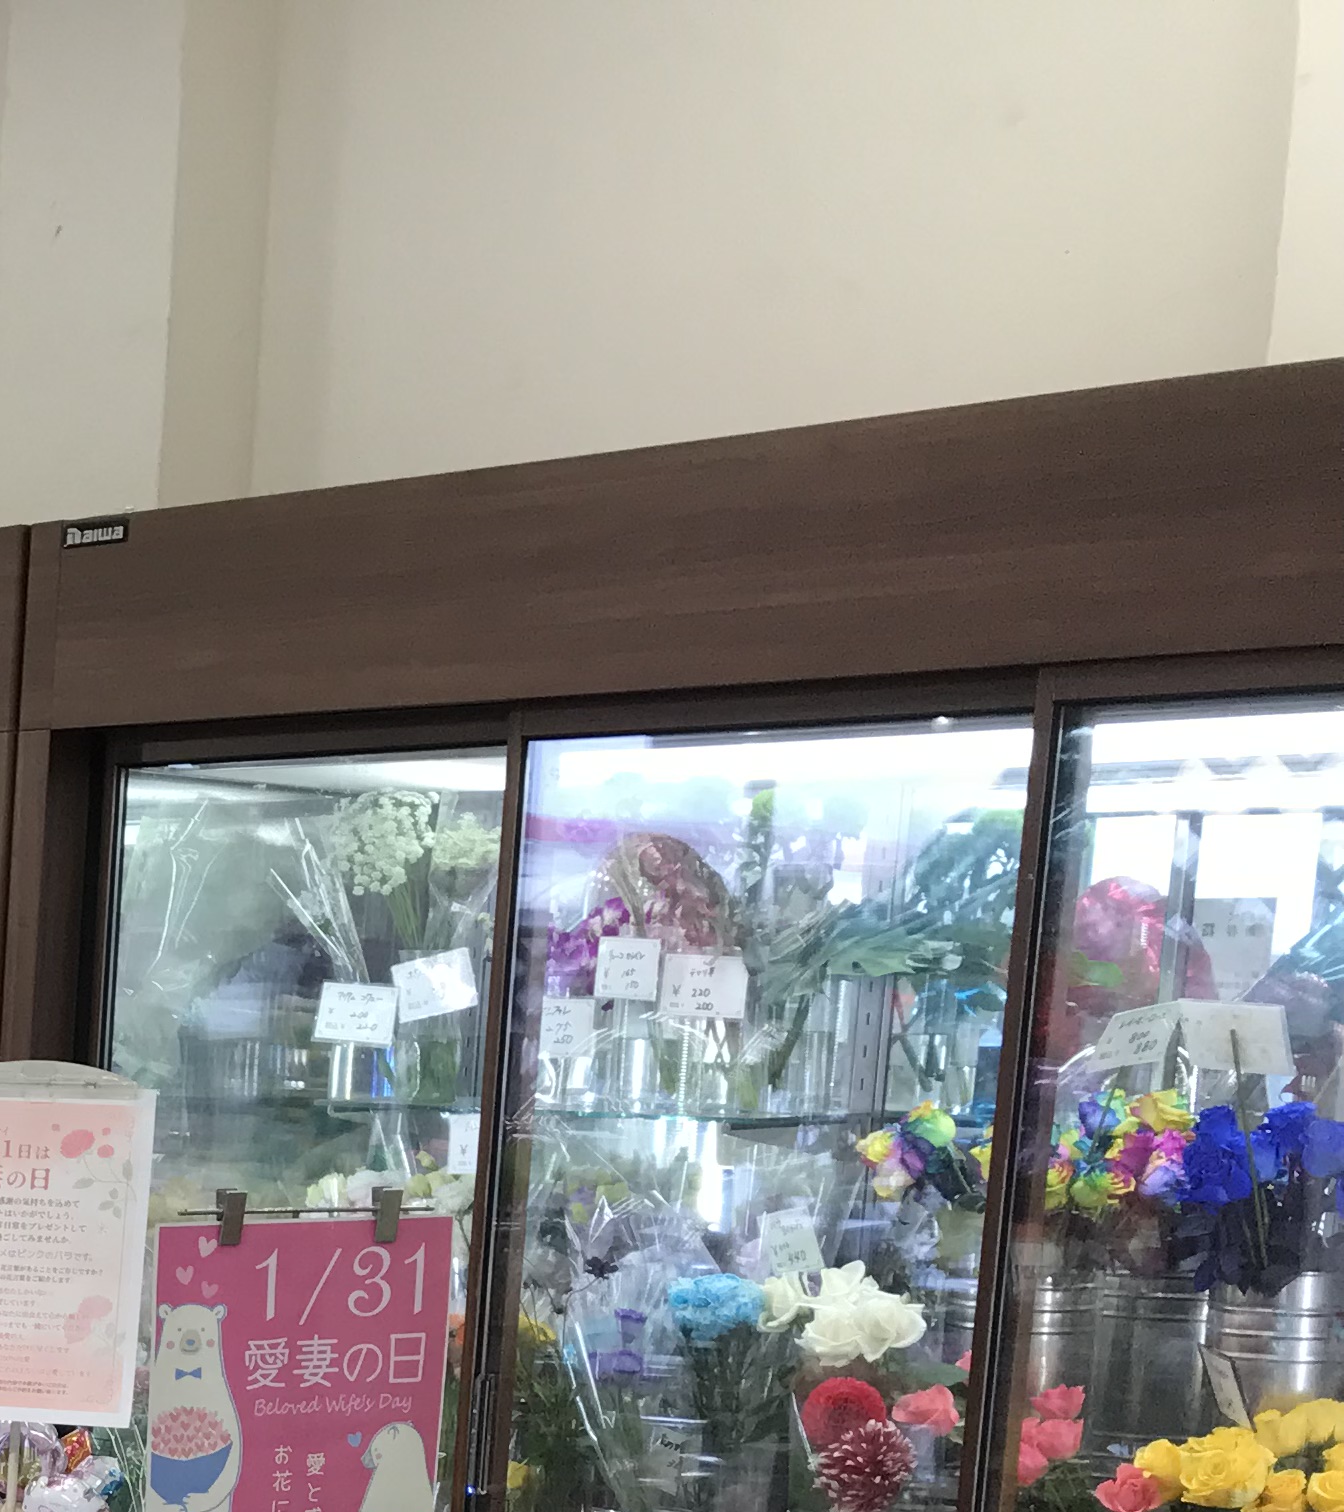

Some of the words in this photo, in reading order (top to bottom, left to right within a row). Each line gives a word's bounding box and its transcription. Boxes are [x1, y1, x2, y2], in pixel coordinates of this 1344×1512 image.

[255, 1242, 427, 1326] 1/31
[244, 1331, 427, 1391] 愛妻の日
[253, 1395, 322, 1418] Beloved
[325, 1394, 373, 1417] Wife's
[378, 1393, 414, 1415] Day
